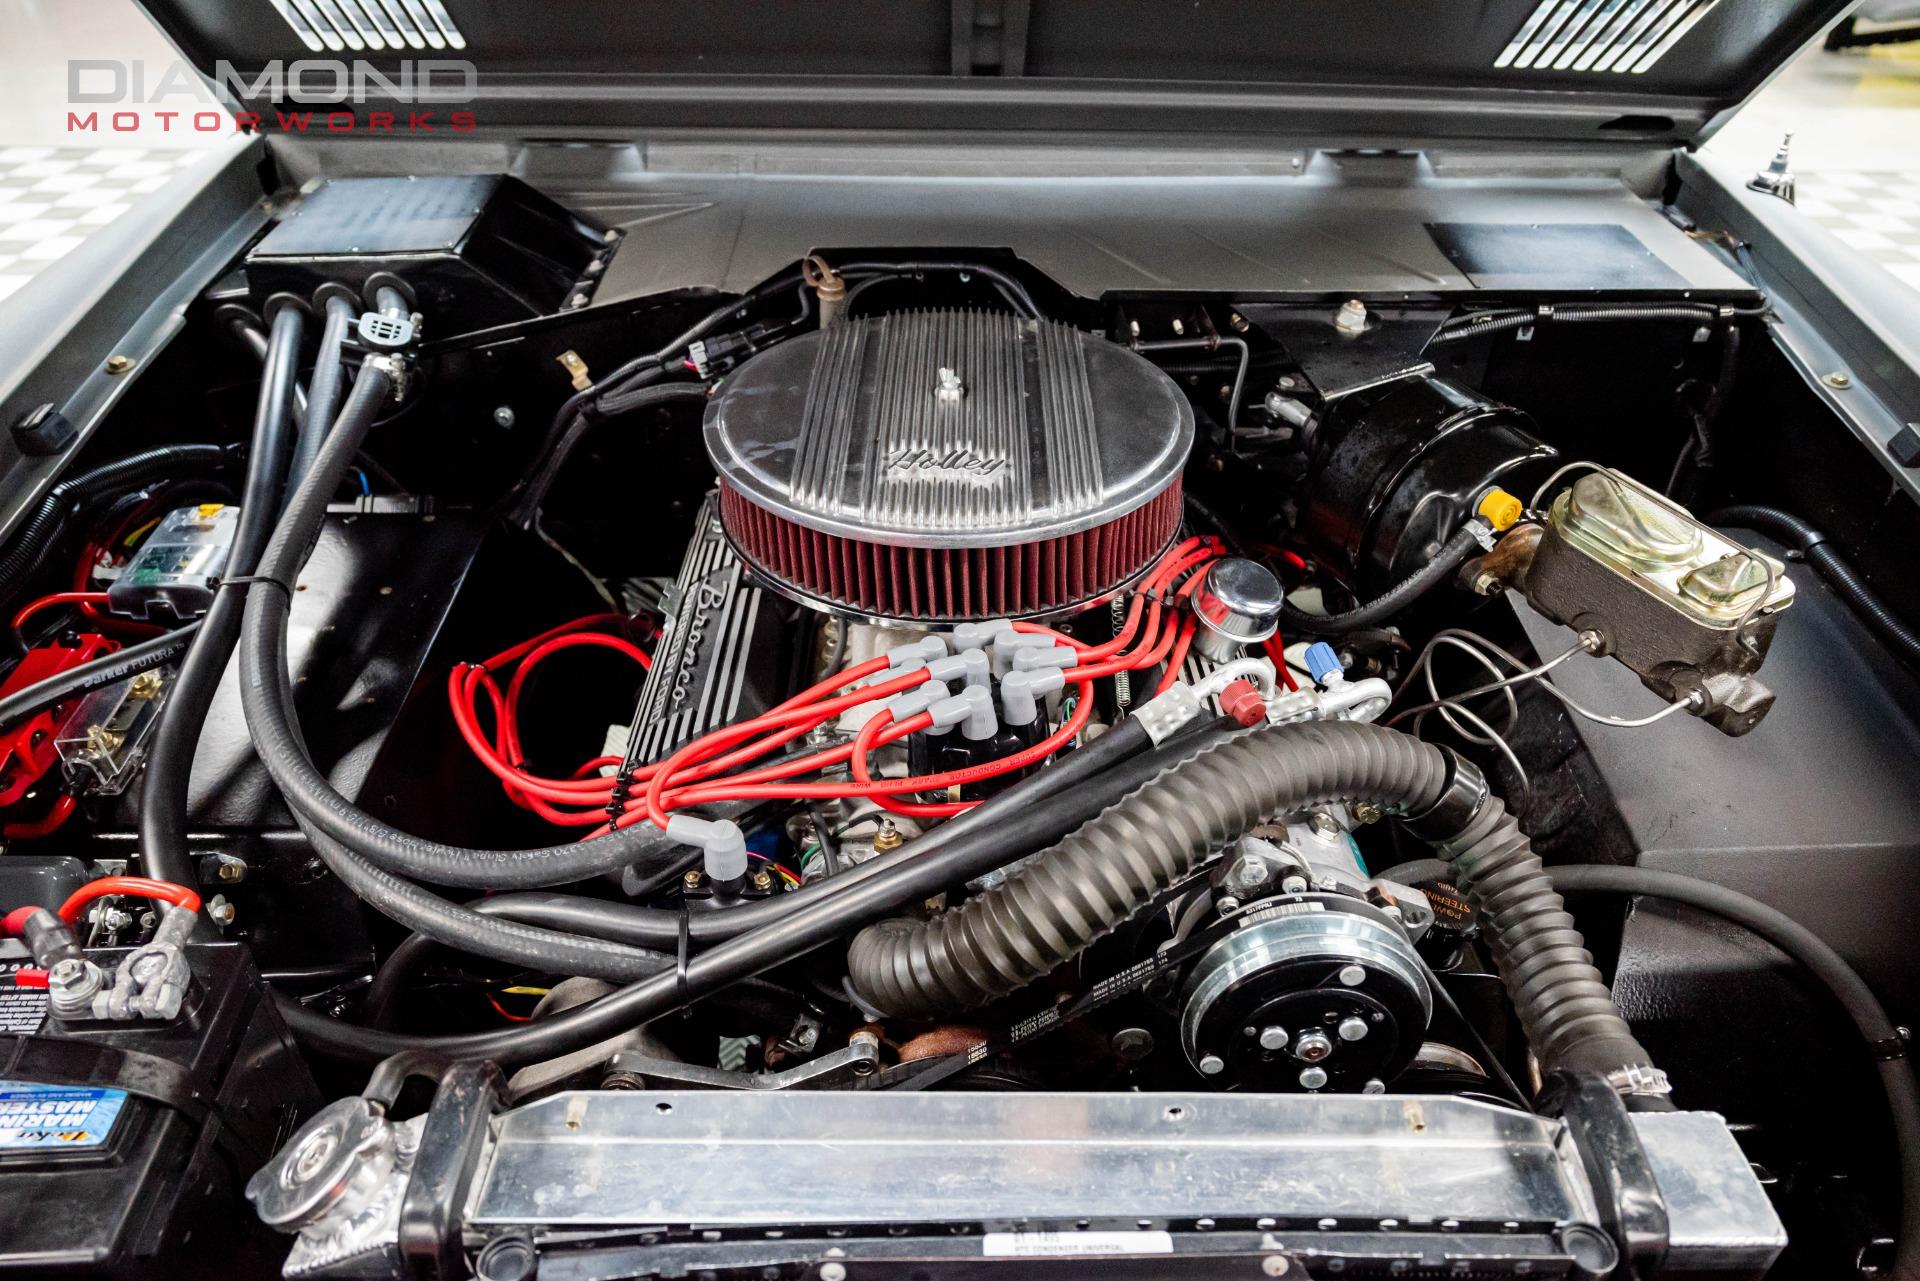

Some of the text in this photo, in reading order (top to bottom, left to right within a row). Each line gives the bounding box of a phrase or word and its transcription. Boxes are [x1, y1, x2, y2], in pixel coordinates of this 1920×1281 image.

[888, 448, 1005, 475] Holley
[651, 582, 698, 722] POWERED BY FORD
[672, 577, 728, 710] Bronco
[132, 648, 174, 669] FUTURA
[949, 763, 1000, 779] CONDUCTOR
